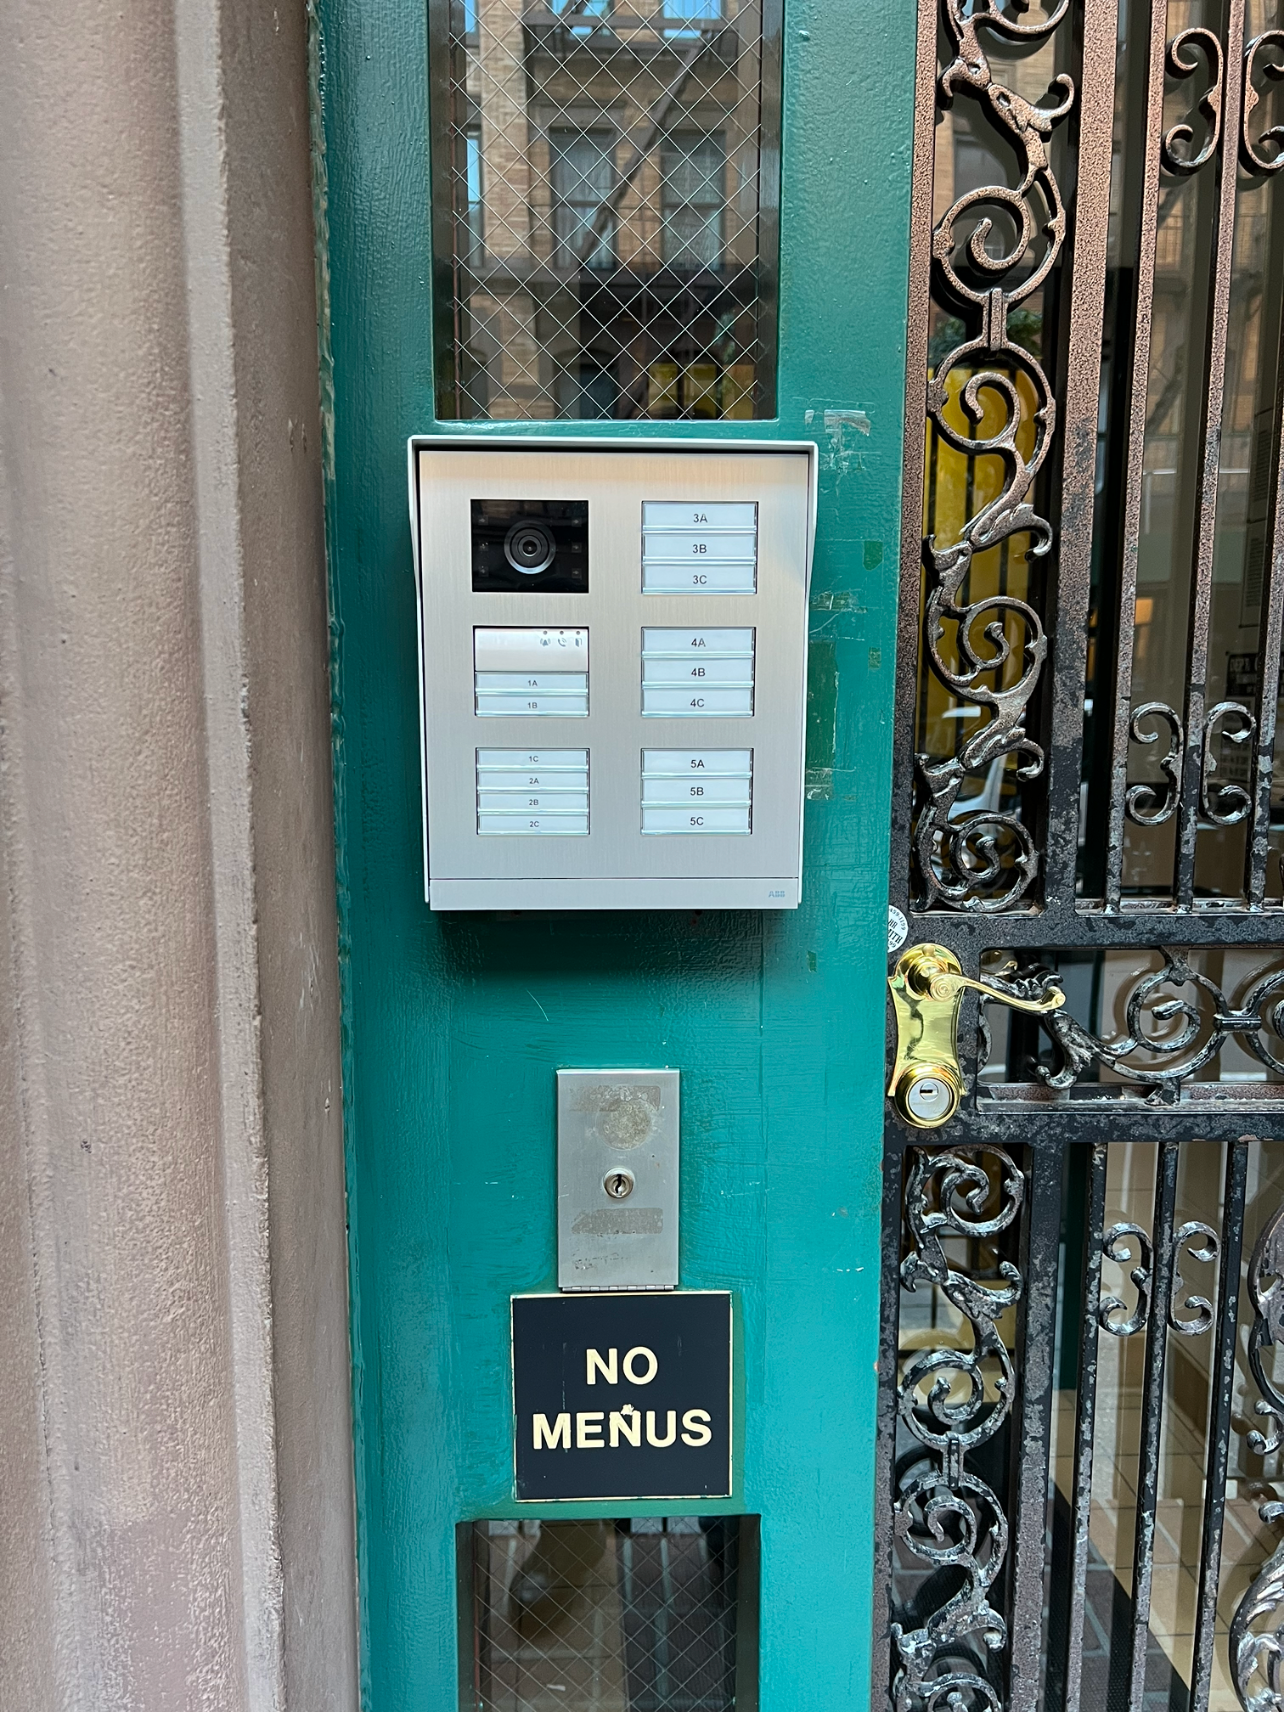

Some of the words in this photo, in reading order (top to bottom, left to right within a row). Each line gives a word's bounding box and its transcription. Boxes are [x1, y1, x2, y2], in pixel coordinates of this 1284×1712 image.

[693, 513, 708, 523] 3A
[692, 543, 707, 554] 3B
[692, 574, 707, 584] 3C
[691, 638, 706, 648] 4A
[690, 667, 706, 677] 4B
[689, 698, 705, 708] 4C
[528, 755, 539, 763] 1C
[690, 759, 705, 769] 5A
[529, 777, 539, 785] 2A
[690, 786, 704, 797] 5B
[528, 798, 539, 806] 2B
[529, 820, 539, 828] 2C
[689, 816, 704, 826] 5C
[586, 1346, 659, 1385] NO
